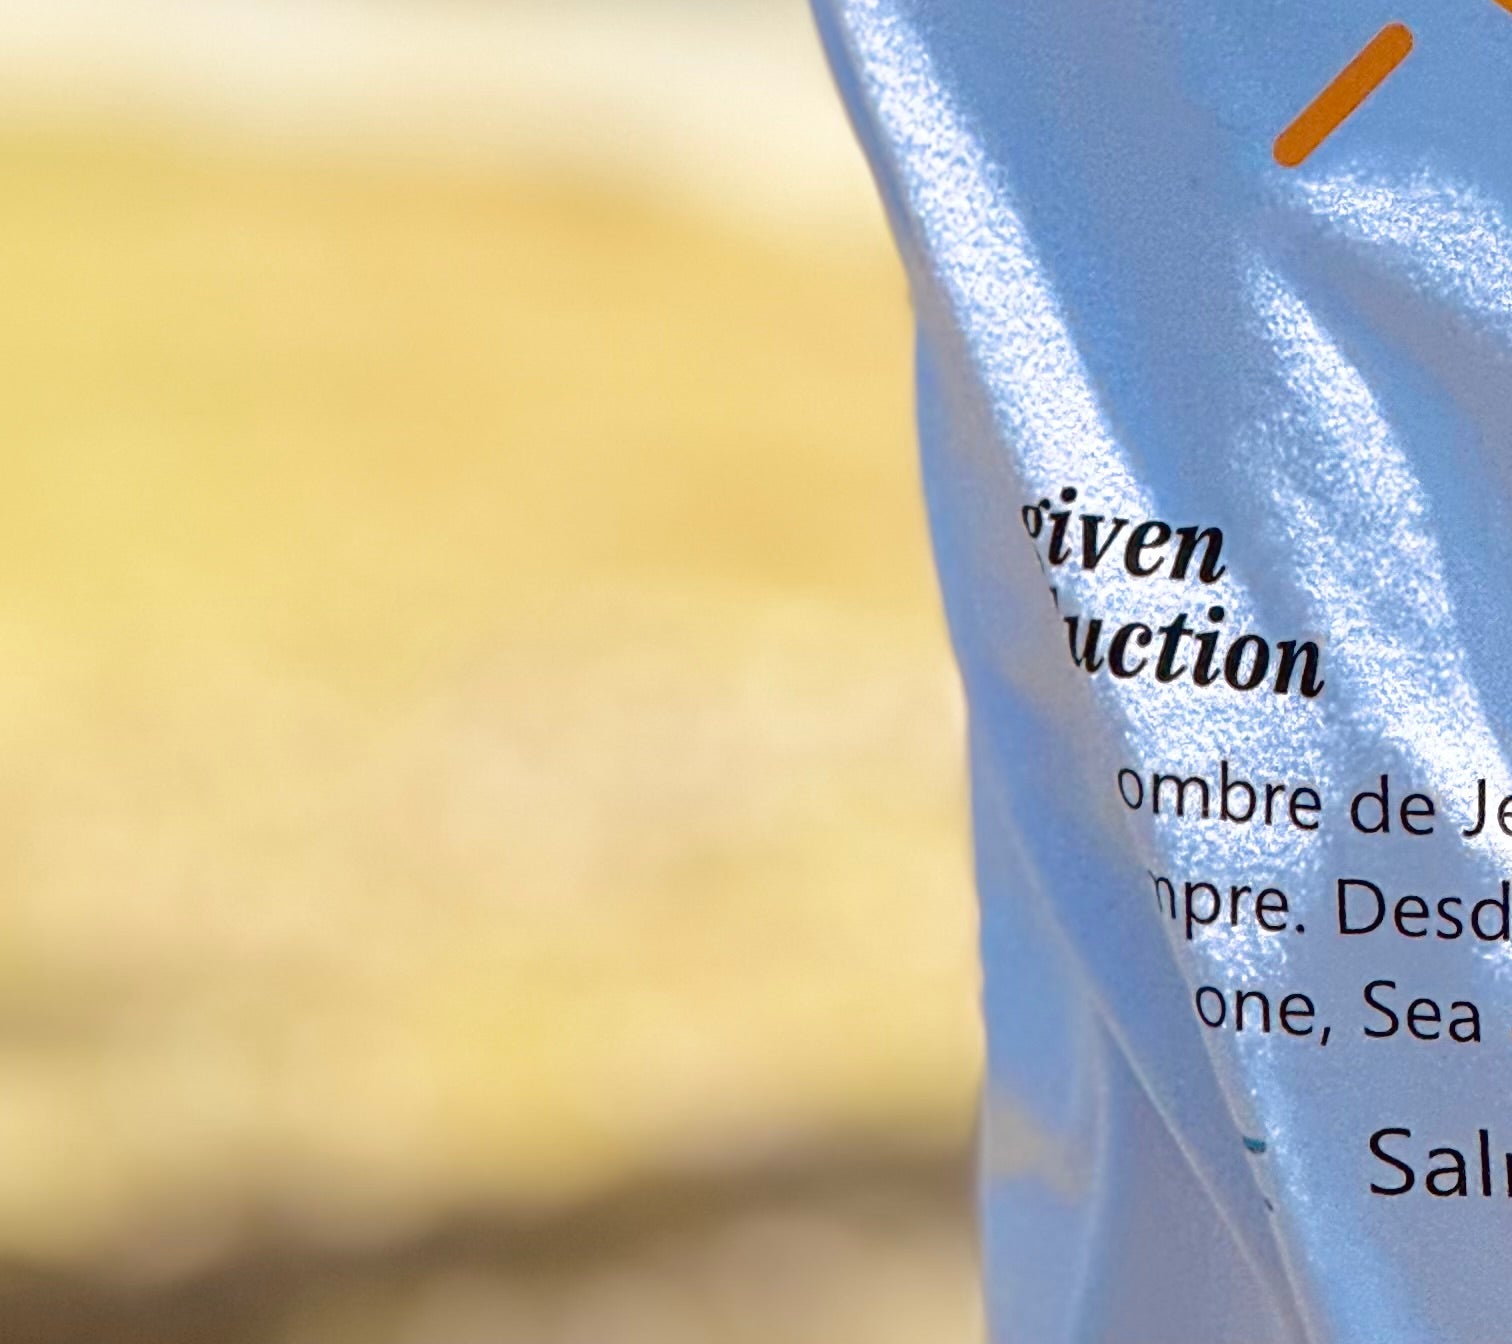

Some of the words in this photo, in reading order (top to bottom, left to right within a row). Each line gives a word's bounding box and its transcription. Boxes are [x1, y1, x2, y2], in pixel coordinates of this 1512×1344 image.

[1049, 585, 1326, 700] uction
[1116, 759, 1323, 832] ombre
[1349, 773, 1436, 837] de
[1362, 978, 1482, 1044] Sea
